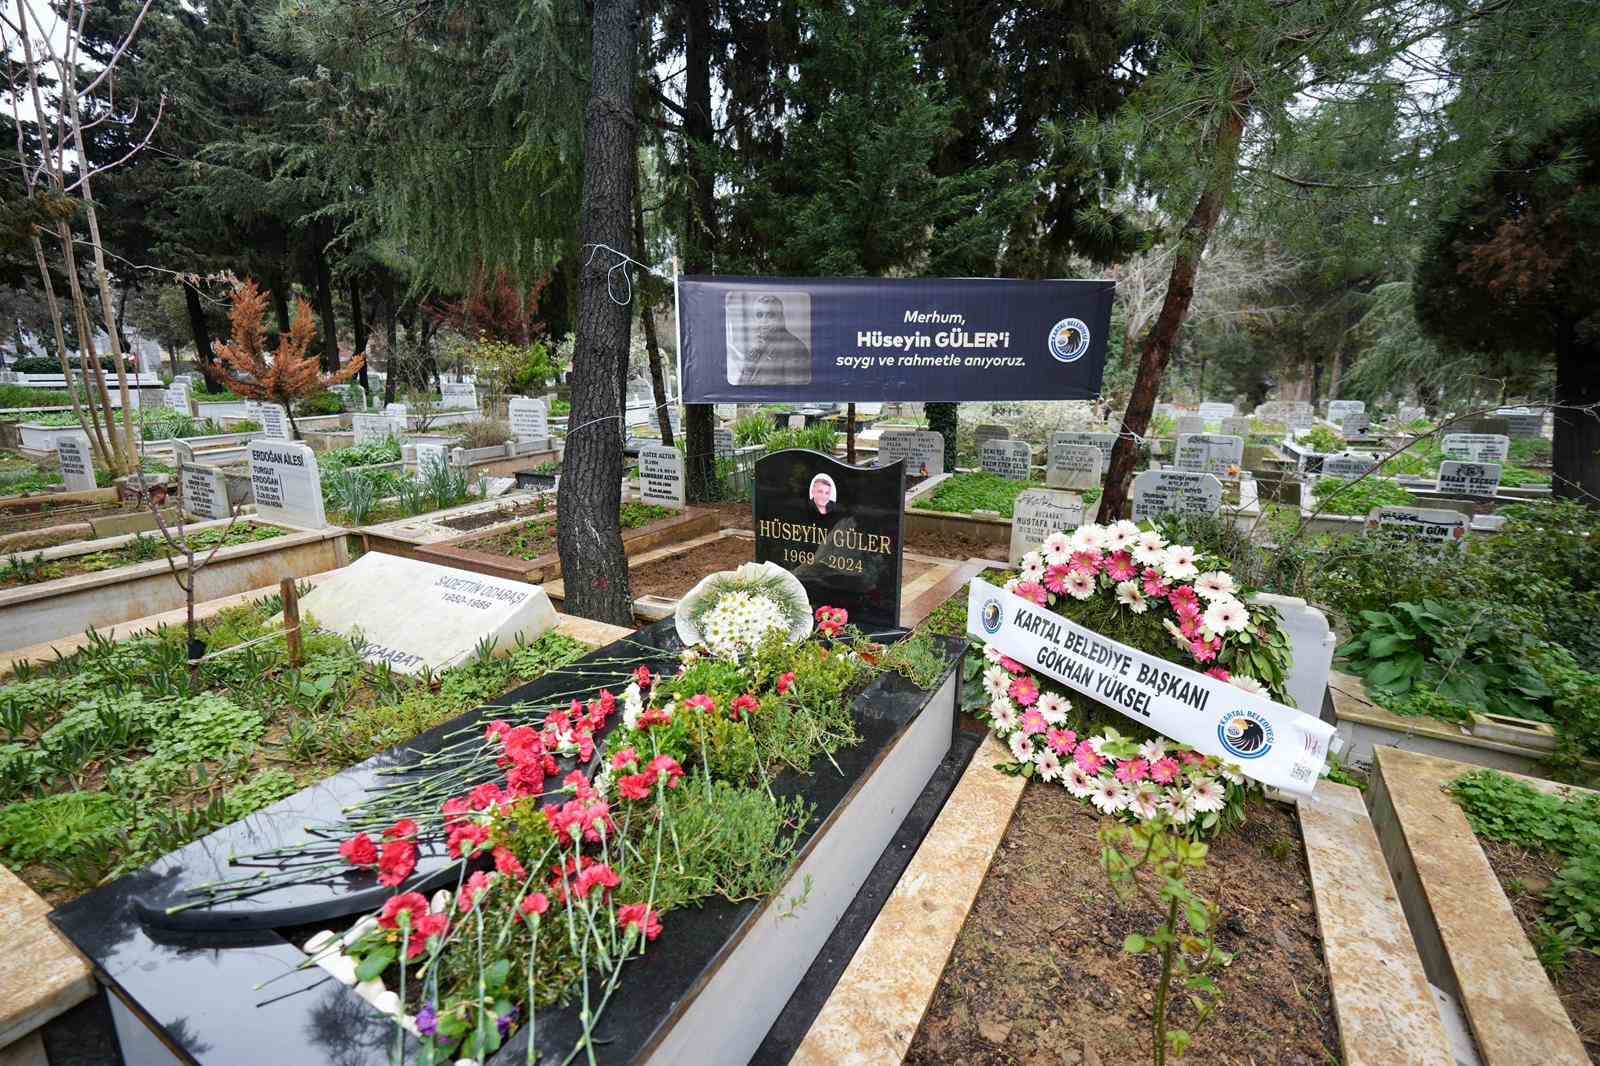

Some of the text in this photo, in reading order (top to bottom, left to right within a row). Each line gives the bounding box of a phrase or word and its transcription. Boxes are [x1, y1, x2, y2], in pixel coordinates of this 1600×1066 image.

[903, 310, 966, 325] Merhum,
[857, 328, 1010, 351] Hüseyin GÜLER'i
[836, 354, 1026, 369] saygı ve rahmetle anıyoruz.
[252, 450, 305, 467] ERDOĞAN AİLESİ
[1016, 517, 1048, 528] MUSTAFA
[1426, 526, 1449, 537] GÜN
[760, 518, 891, 555] HÜSEYİN GÜLER
[784, 549, 815, 566] 1969
[829, 555, 864, 573] 2024
[1013, 608, 1063, 645] KARTAL
[1065, 630, 1133, 676] BELEDİYE
[1138, 662, 1211, 711] BAŞKANI
[1036, 646, 1152, 718] GÖKHAN YÜKSEL
[1220, 710, 1245, 725] KARTAL
[1246, 710, 1275, 744] BELEDİYESİ
